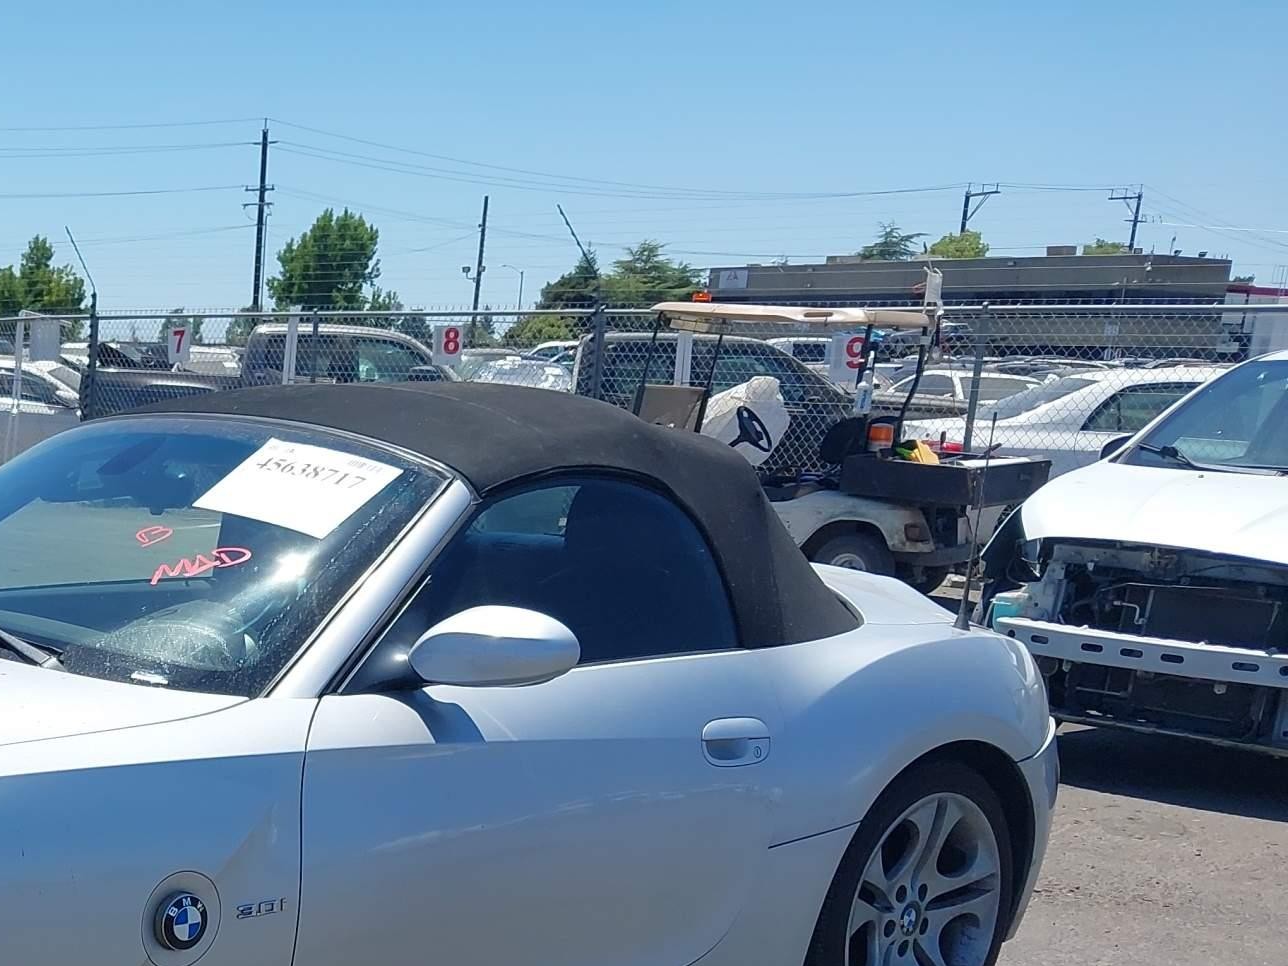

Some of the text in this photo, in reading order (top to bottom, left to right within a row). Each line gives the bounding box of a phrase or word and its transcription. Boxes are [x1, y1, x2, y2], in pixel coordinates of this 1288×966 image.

[173, 329, 185, 354] 7
[443, 327, 460, 355] 8
[256, 457, 367, 489] 45638717
[168, 896, 205, 917] BMW
